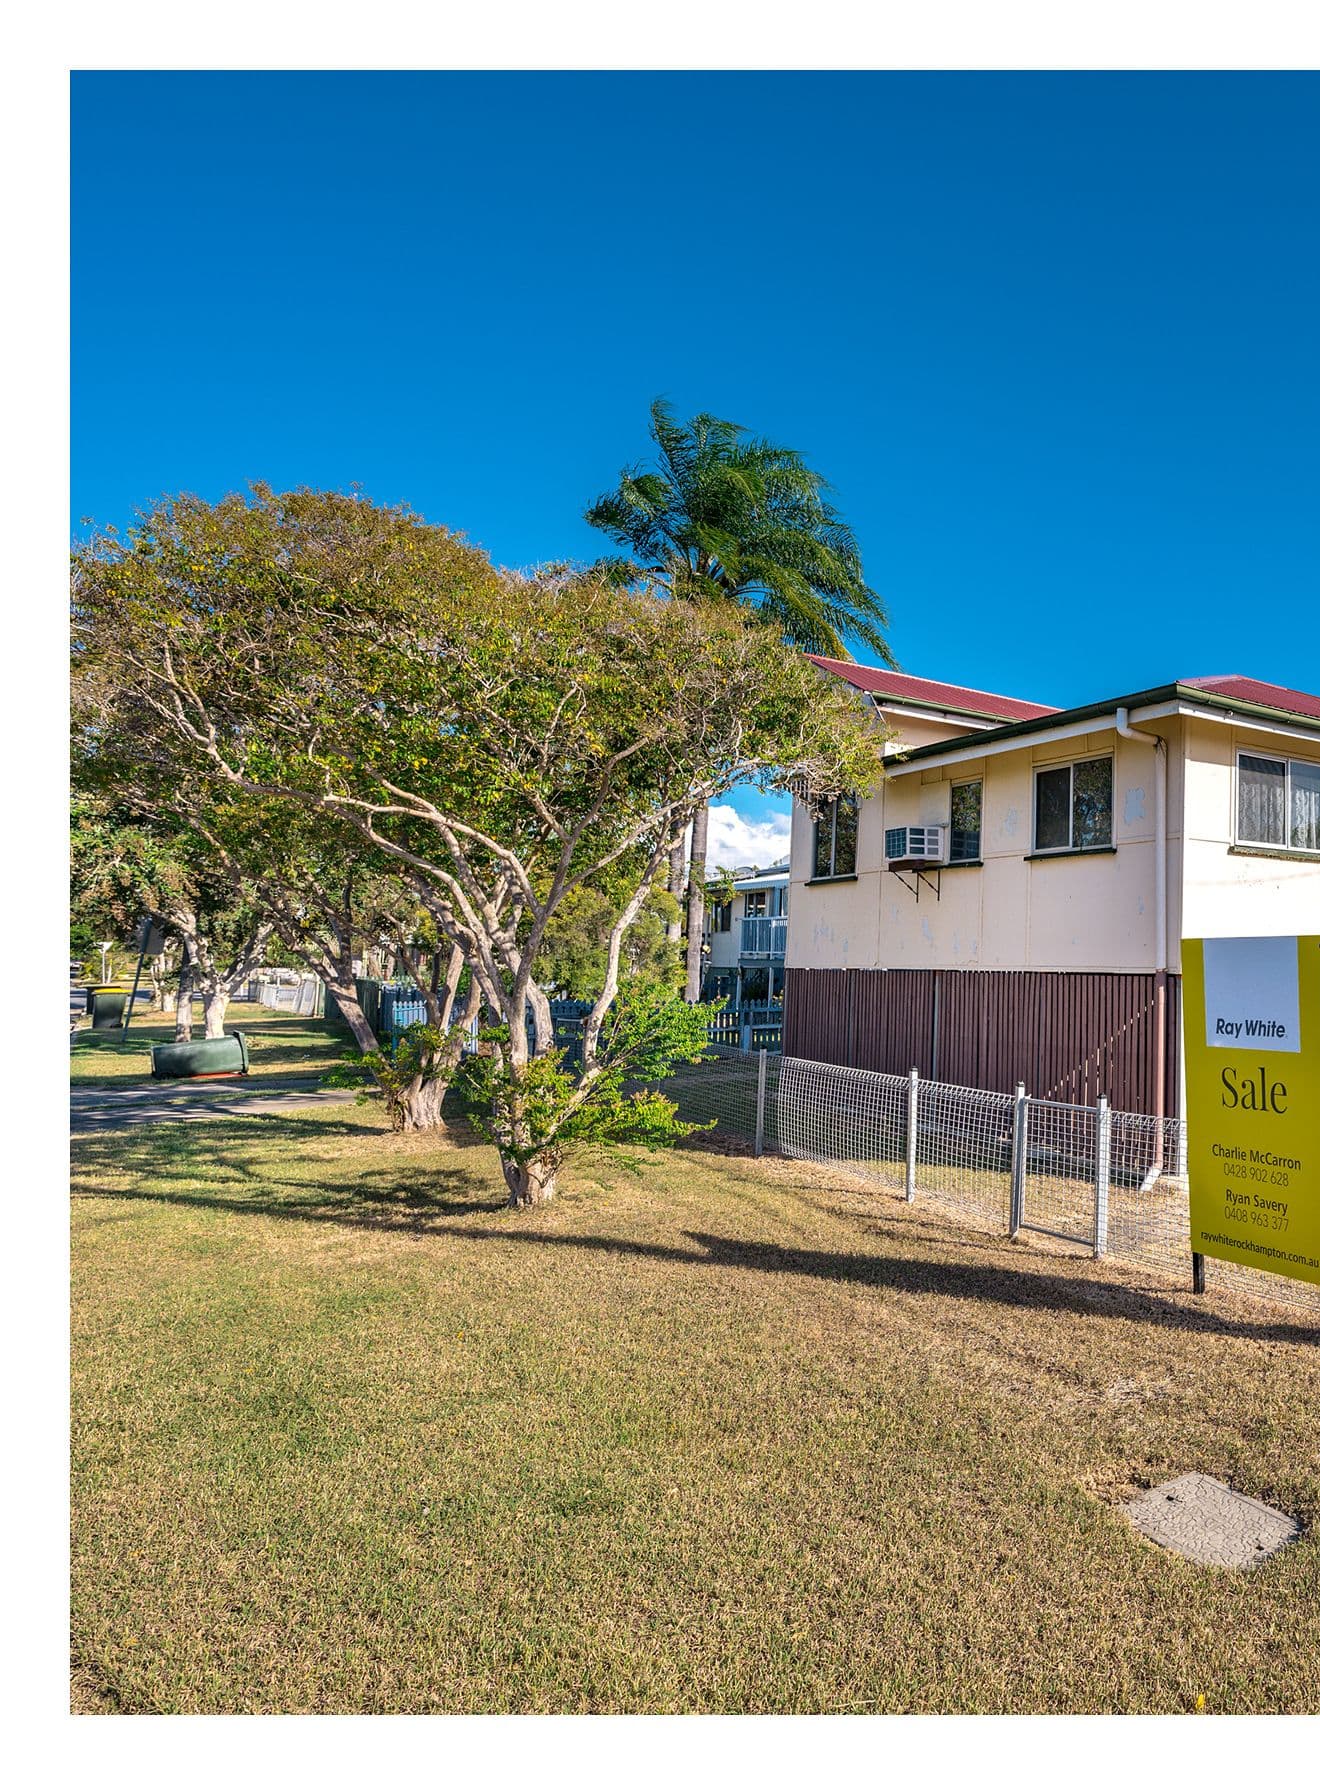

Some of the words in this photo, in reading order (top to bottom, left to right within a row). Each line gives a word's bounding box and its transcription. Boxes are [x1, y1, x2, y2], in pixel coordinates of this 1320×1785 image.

[1215, 1018, 1243, 1038] Ray
[1245, 1019, 1286, 1038] White
[1221, 1067, 1288, 1114] Sale
[1211, 1143, 1247, 1161] Charlie
[1249, 1150, 1301, 1171] McCarron
[1223, 1162, 1248, 1179] 0428
[1249, 1166, 1268, 1183] 902
[1270, 1171, 1290, 1187] 628
[1225, 1189, 1251, 1206] Ryan
[1253, 1194, 1288, 1216] Savery
[1224, 1205, 1249, 1223] 0408
[1250, 1211, 1269, 1228] 963
[1271, 1215, 1290, 1232] 377
[1200, 1231, 1320, 1268] raywhiterockhampton.com.au
